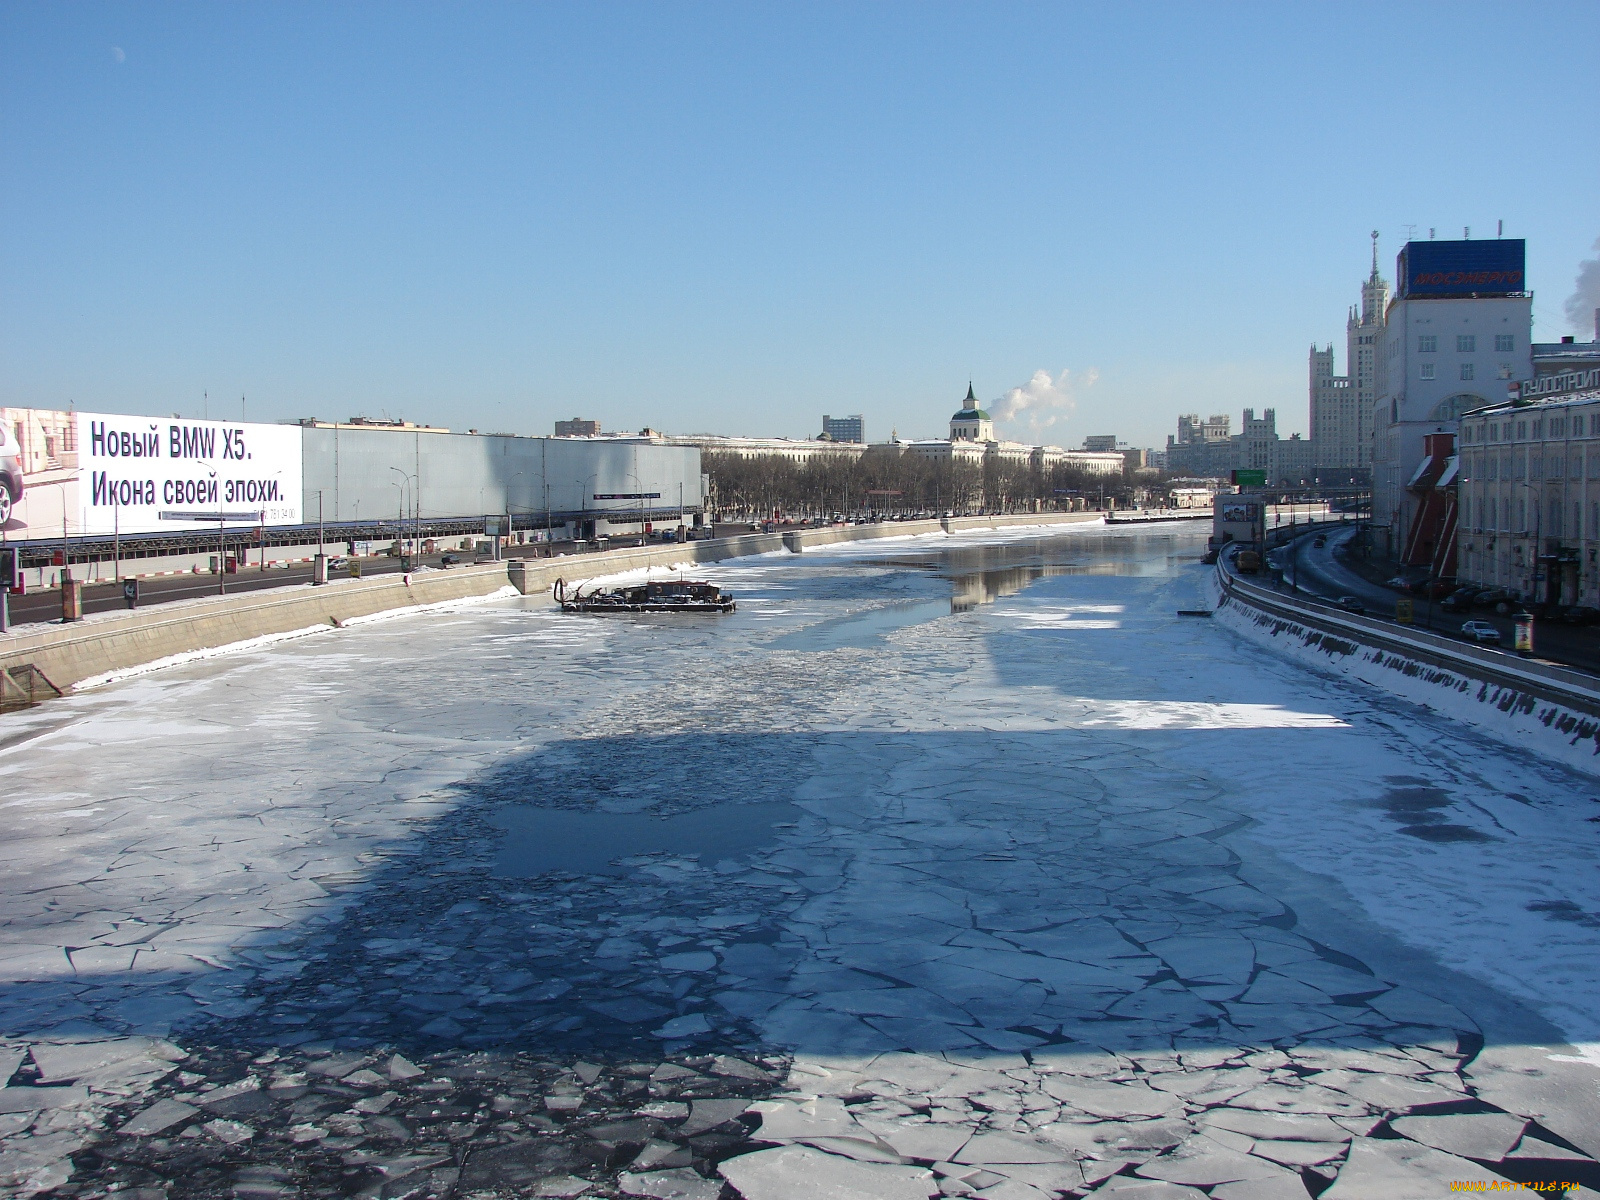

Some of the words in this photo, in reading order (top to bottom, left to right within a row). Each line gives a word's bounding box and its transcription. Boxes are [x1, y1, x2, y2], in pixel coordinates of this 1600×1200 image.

[1414, 270, 1521, 285] МОСЭНЕРГО
[91, 421, 159, 457] Новый
[169, 425, 215, 459] BMW
[223, 428, 252, 460] X5.
[92, 471, 155, 506] Икона
[164, 471, 218, 504] своей
[225, 480, 284, 502] эпохи.
